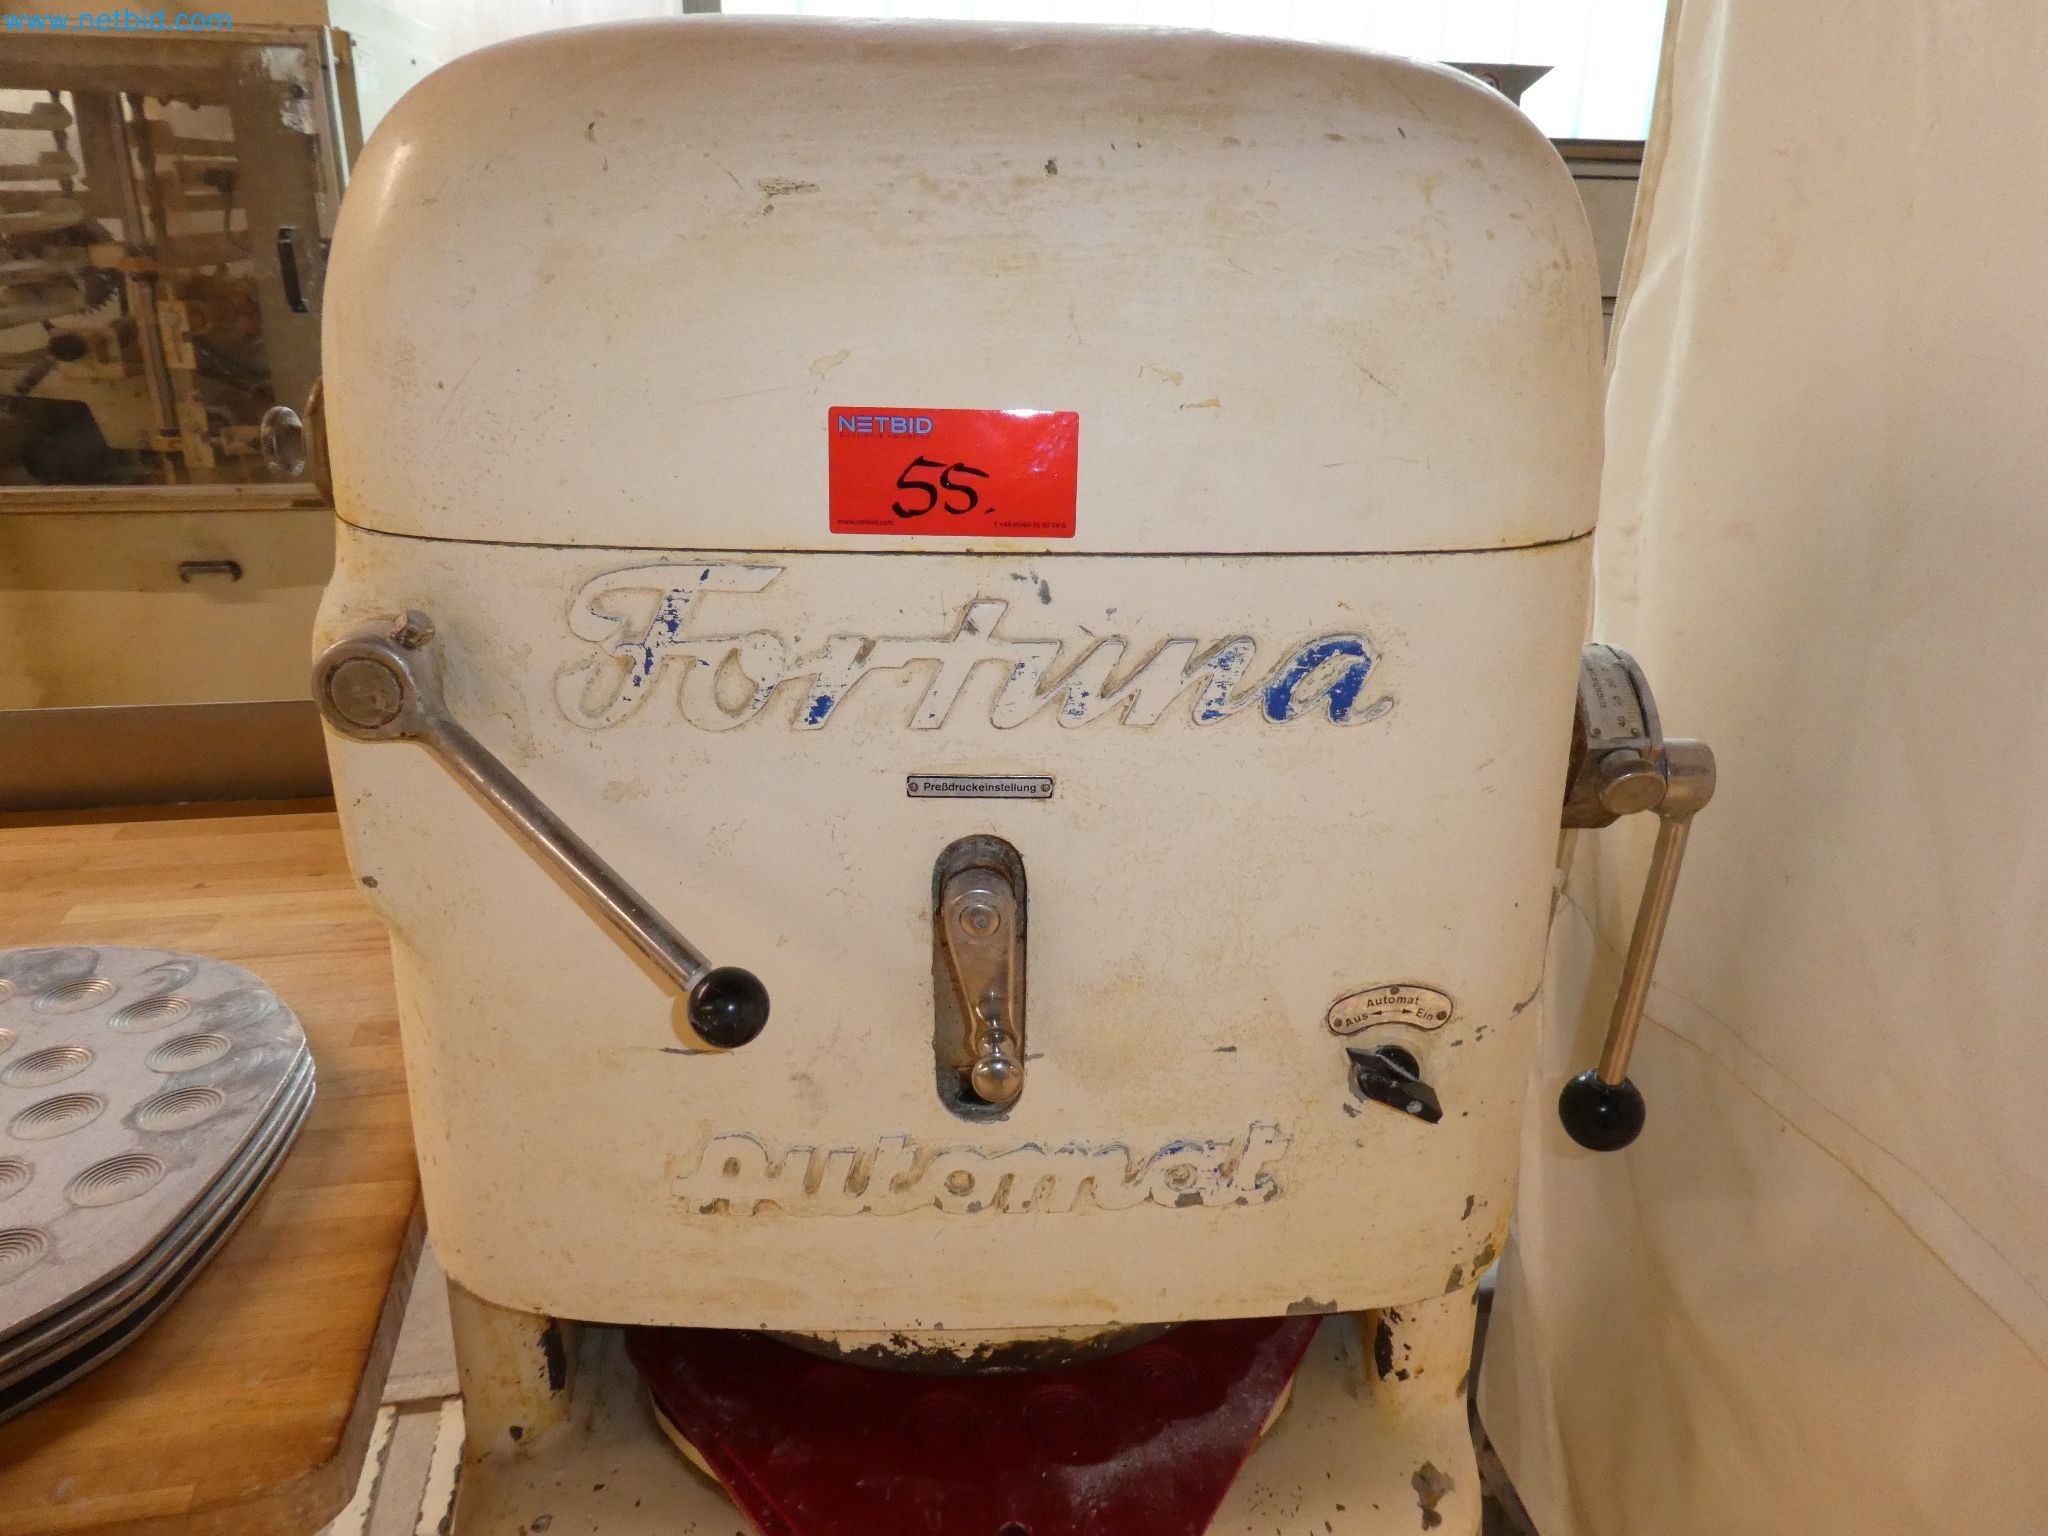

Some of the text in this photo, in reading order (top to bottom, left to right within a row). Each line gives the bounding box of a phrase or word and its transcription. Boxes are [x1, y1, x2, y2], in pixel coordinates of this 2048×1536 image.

[838, 416, 933, 433] NETBID
[554, 564, 1396, 731] Fortuna
[923, 782, 1037, 793] Preßdruckeinstellung
[1366, 995, 1420, 1008] Automat
[1345, 1007, 1434, 1027] Aus Ein
